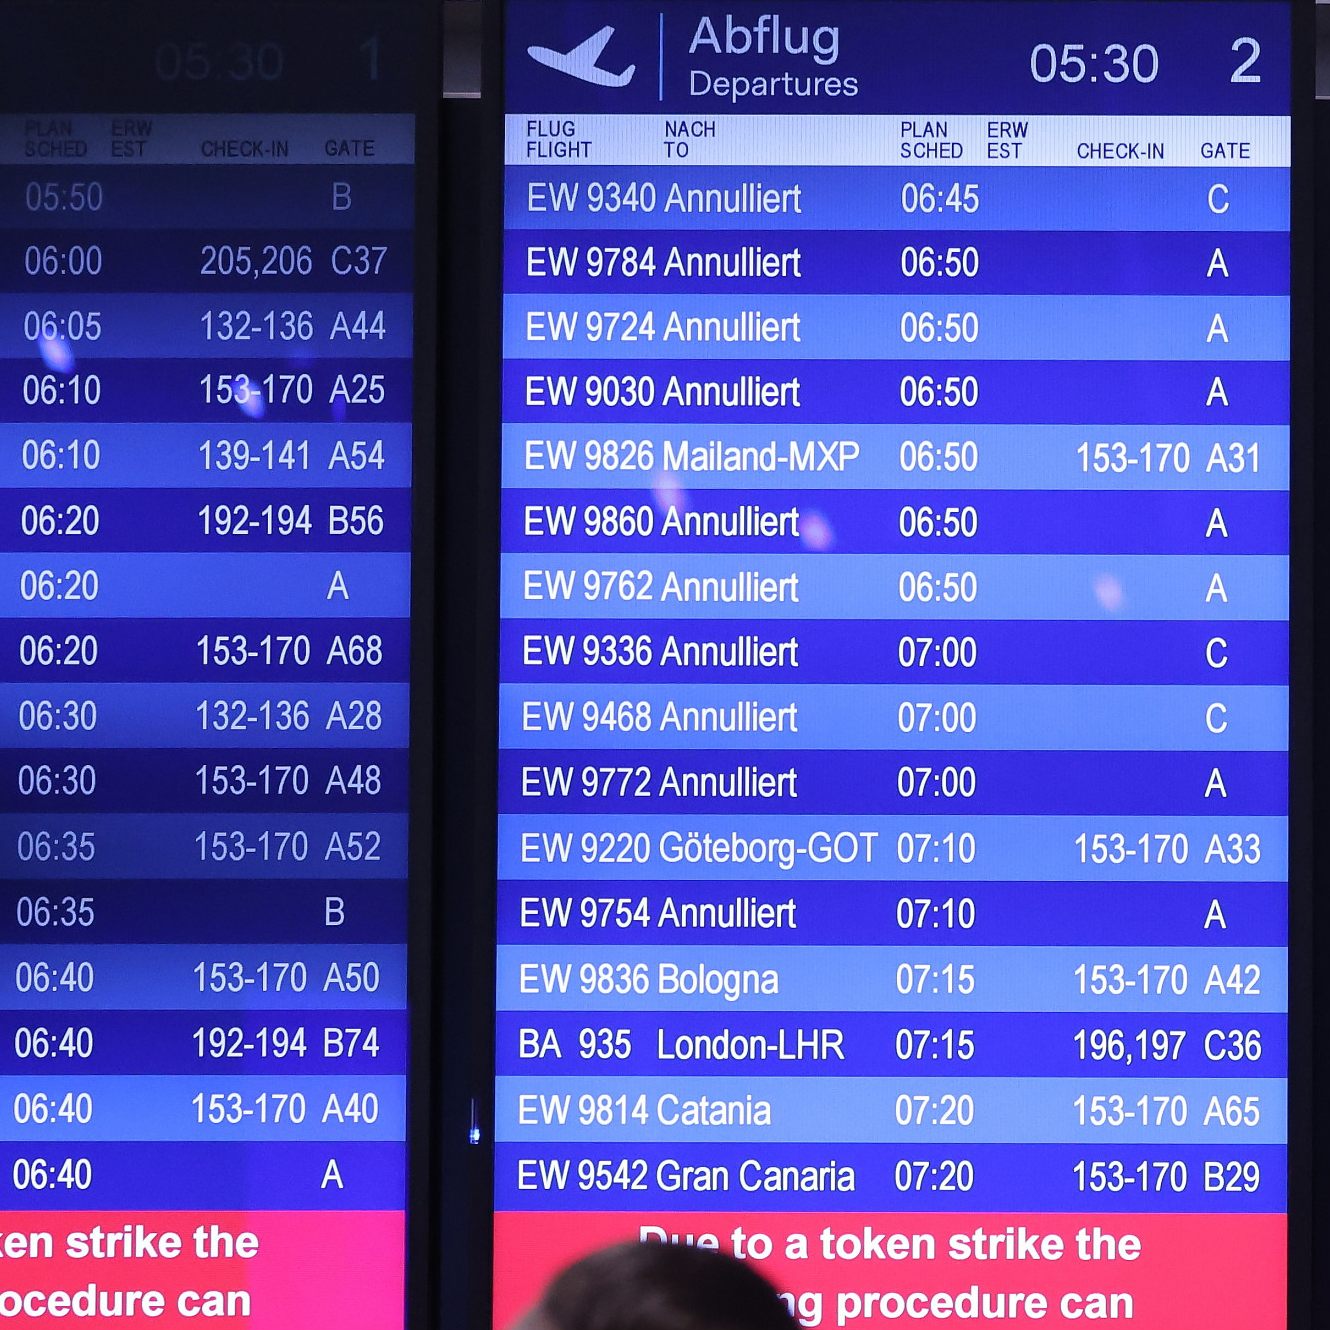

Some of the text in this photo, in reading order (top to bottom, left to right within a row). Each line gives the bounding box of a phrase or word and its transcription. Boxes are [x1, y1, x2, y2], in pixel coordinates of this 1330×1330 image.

[689, 15, 838, 65] Abflug
[156, 35, 378, 80] 05:30 1
[1031, 37, 1260, 83] 05:30 2
[691, 71, 858, 103] Departures
[528, 120, 1028, 138] FLUG NACH PLAN ERW
[202, 140, 288, 157] CHECK-IN
[325, 140, 375, 156] GATE
[527, 141, 1250, 159] FLIGHT TO SCHED EST CHECK-IN GATE
[529, 182, 1229, 213] EW 9340 Annulliert 06:45 C
[25, 246, 387, 279] 06:00 205,206 C37
[23, 439, 384, 470] 06:10 139-141 A54
[522, 831, 1260, 869] EW 9220 Göteborg-GOT 07:10 153-170 A33
[15, 1027, 379, 1058] 06:40 192-194 B74
[520, 1028, 1261, 1065] BA 935 London-LHR 07:15 196,197 C36
[519, 1159, 1259, 1192] EW 9542 Gran Canaria 07:20 153-170 B29
[66, 1225, 181, 1258] strike
[193, 1225, 258, 1258] the
[731, 1227, 772, 1259] to
[786, 1234, 808, 1259] a
[820, 1227, 934, 1259] token
[949, 1227, 1064, 1260] strike
[1076, 1227, 1141, 1260] the
[178, 1291, 250, 1316] can
[838, 1286, 1047, 1326] procedure
[1061, 1293, 1132, 1319] can
